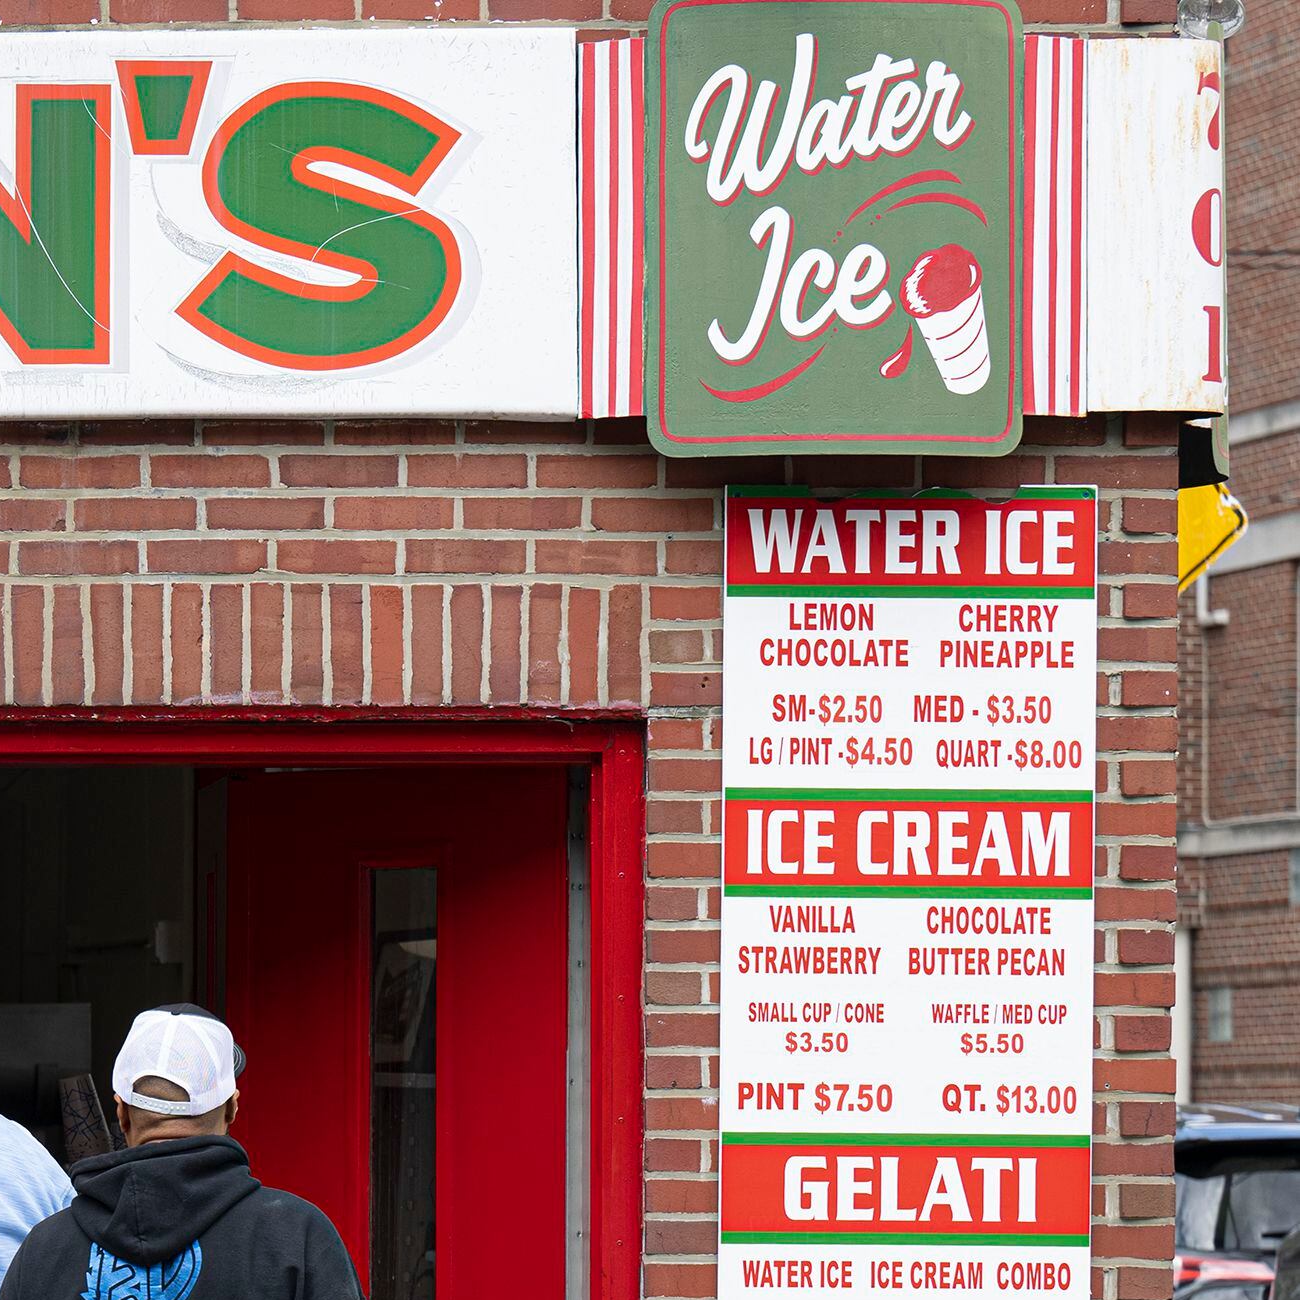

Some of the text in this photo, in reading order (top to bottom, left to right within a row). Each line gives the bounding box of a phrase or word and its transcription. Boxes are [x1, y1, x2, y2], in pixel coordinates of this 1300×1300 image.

[685, 33, 973, 203] Water
[707, 206, 895, 361] Ice
[747, 509, 1074, 574] WATER ICE
[789, 603, 873, 631] LEMON
[959, 604, 1058, 632] CHERRY
[760, 638, 908, 667] CHOCOLATE
[940, 640, 1074, 668] PINEAPPLE
[772, 694, 882, 724] SM-$2.50
[914, 695, 964, 722] MED
[987, 695, 1051, 724] $3.50
[749, 737, 913, 766] LG / PINT -$4.50
[936, 739, 1082, 768] QUART -$8.00
[747, 810, 1070, 876] ICE CREAM
[770, 905, 855, 933] VANILLA
[927, 906, 1051, 935] CHOCOLATE
[738, 946, 881, 974] STRAWBERRY
[909, 948, 1064, 976] BUTTER PECAN
[749, 1002, 884, 1023] SMALL CUP / CONE
[932, 1003, 1067, 1024] WAFFLE / MED CUP
[786, 1031, 848, 1053] $3.50
[961, 1032, 1024, 1054] $5.50
[738, 1082, 892, 1113] PINT $7.50
[942, 1084, 1076, 1114] QT. $13.00
[785, 1156, 1036, 1222] GELATI
[743, 1260, 1071, 1290] WATER ICE ICE CREAM COMBO
